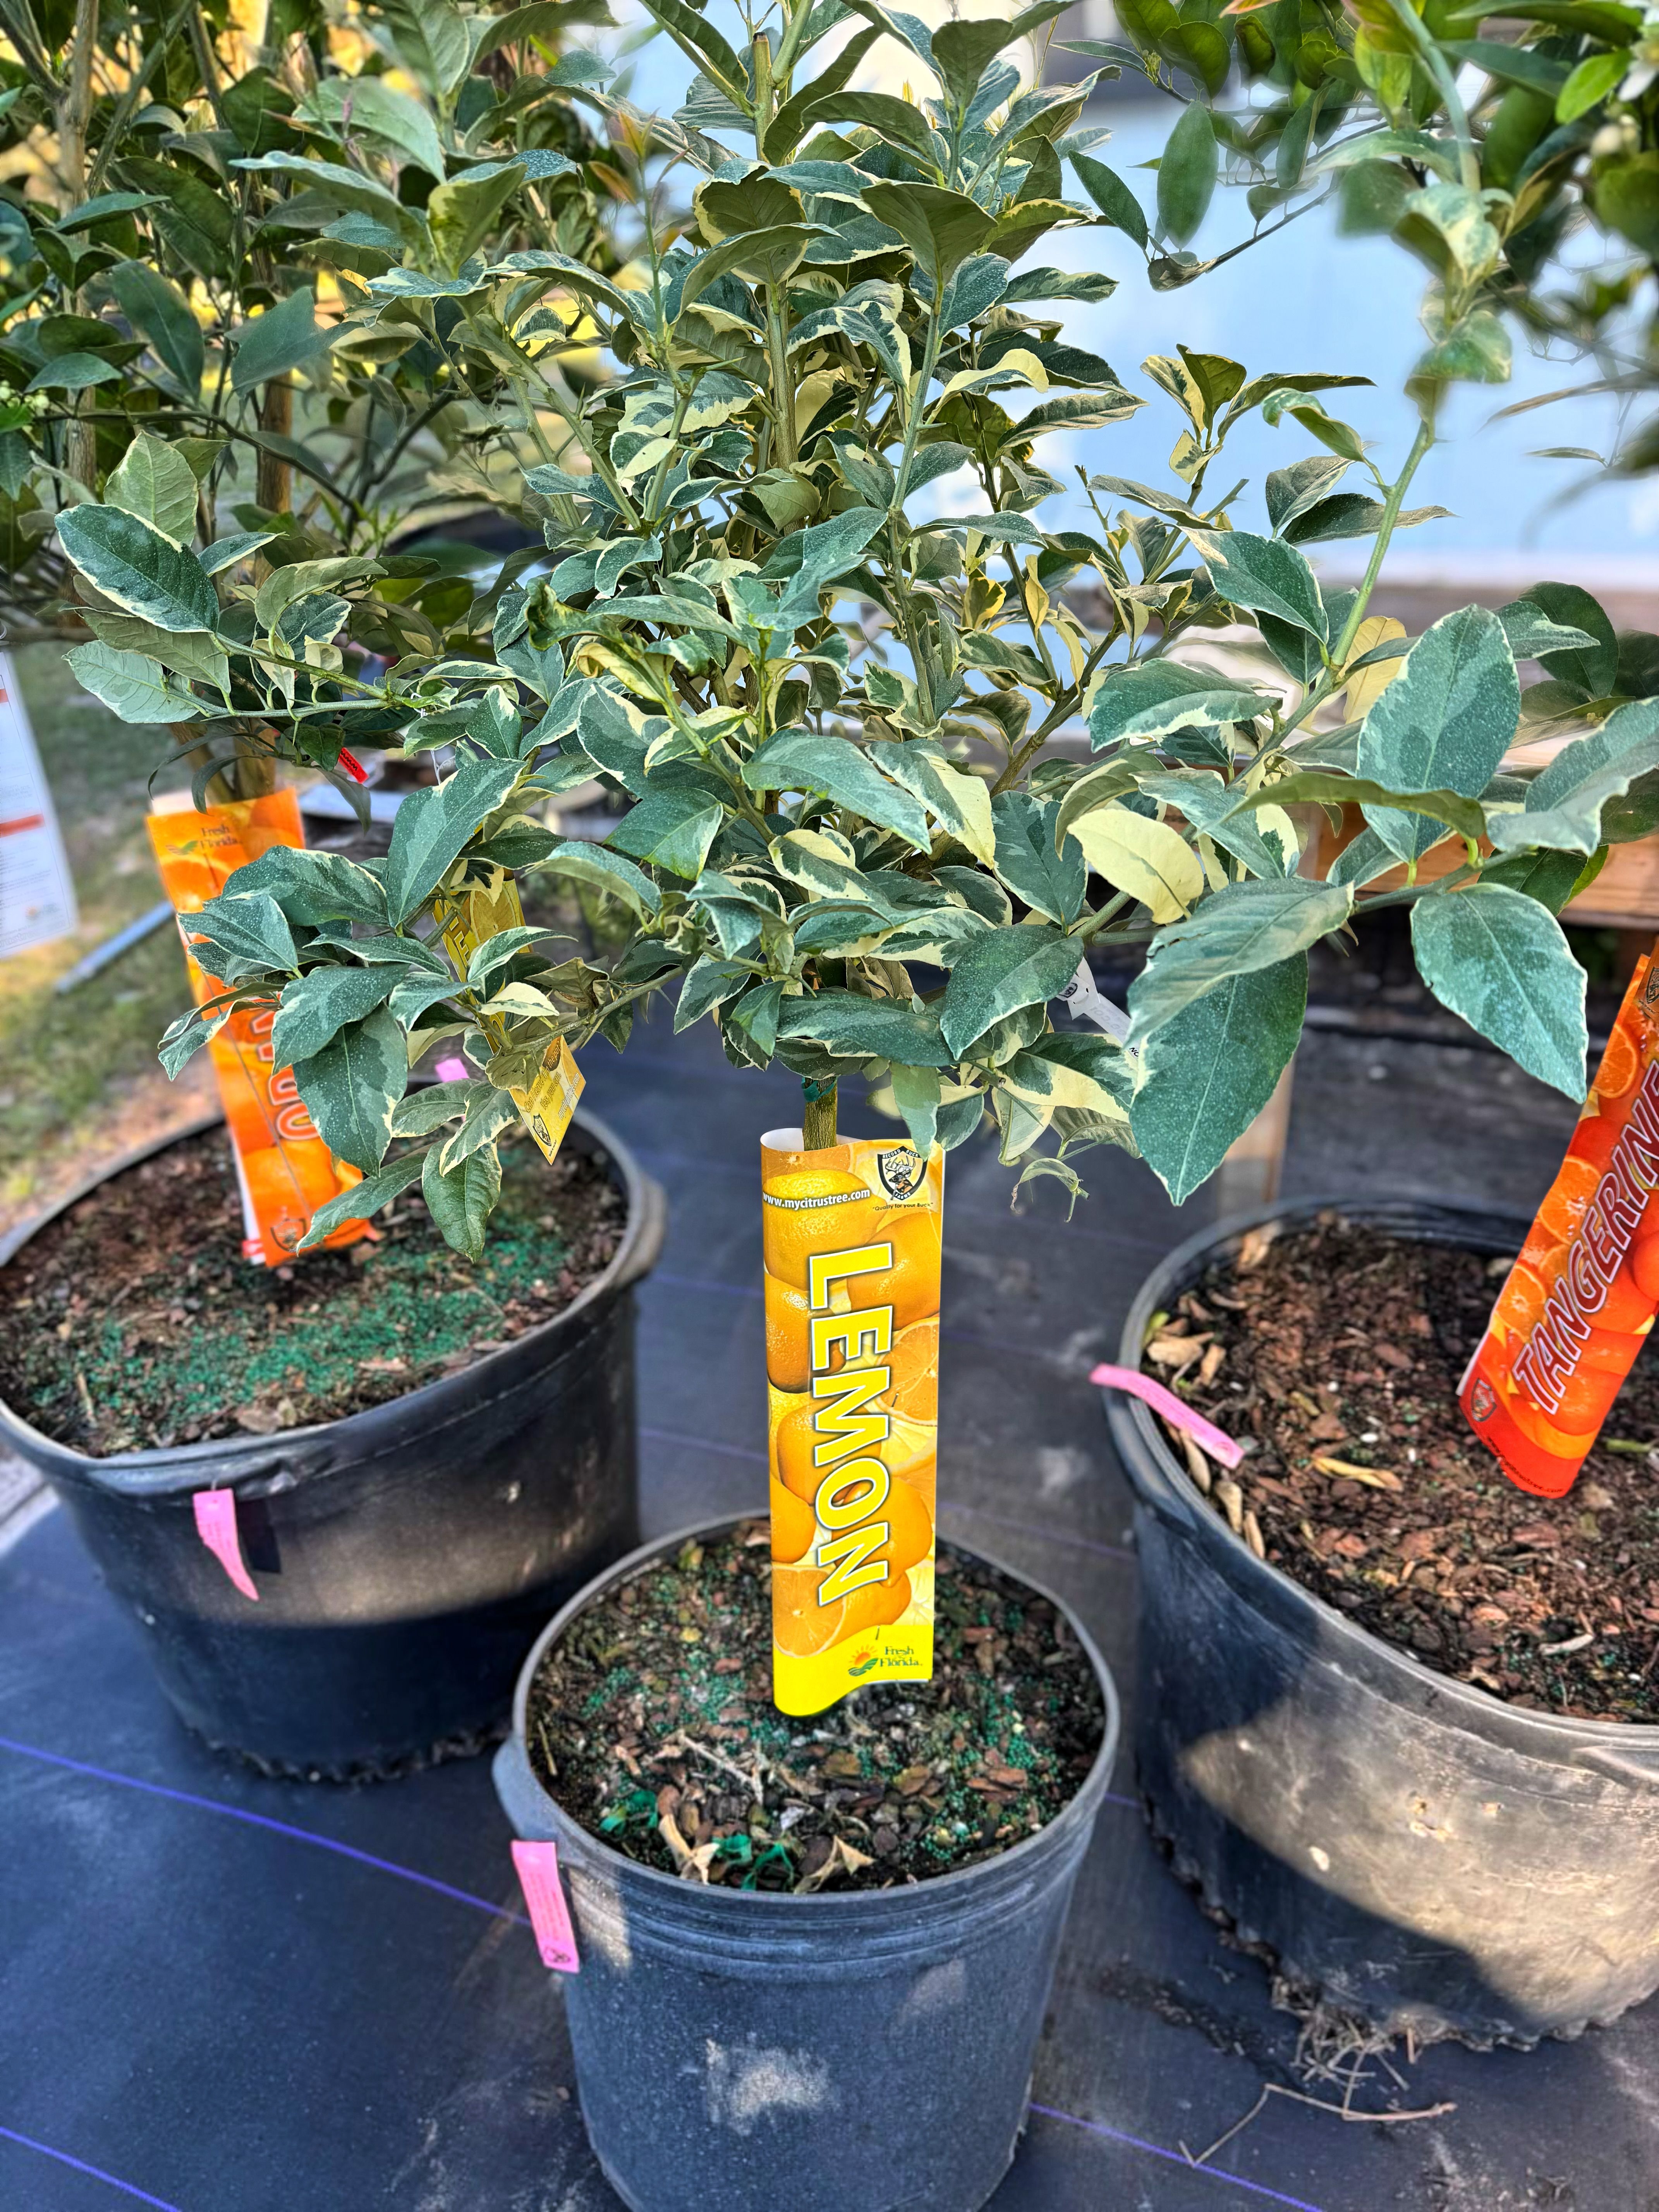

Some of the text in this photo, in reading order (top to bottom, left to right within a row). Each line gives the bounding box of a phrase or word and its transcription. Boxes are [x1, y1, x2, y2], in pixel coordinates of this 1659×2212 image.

[547, 1083, 556, 1102] you
[525, 1097, 534, 1112] Can
[883, 1149, 901, 1158] RECORD
[763, 1189, 870, 1211] www.mycitrustree.com
[809, 1242, 893, 1607] LEMON
[884, 1645, 914, 1655] Fresh
